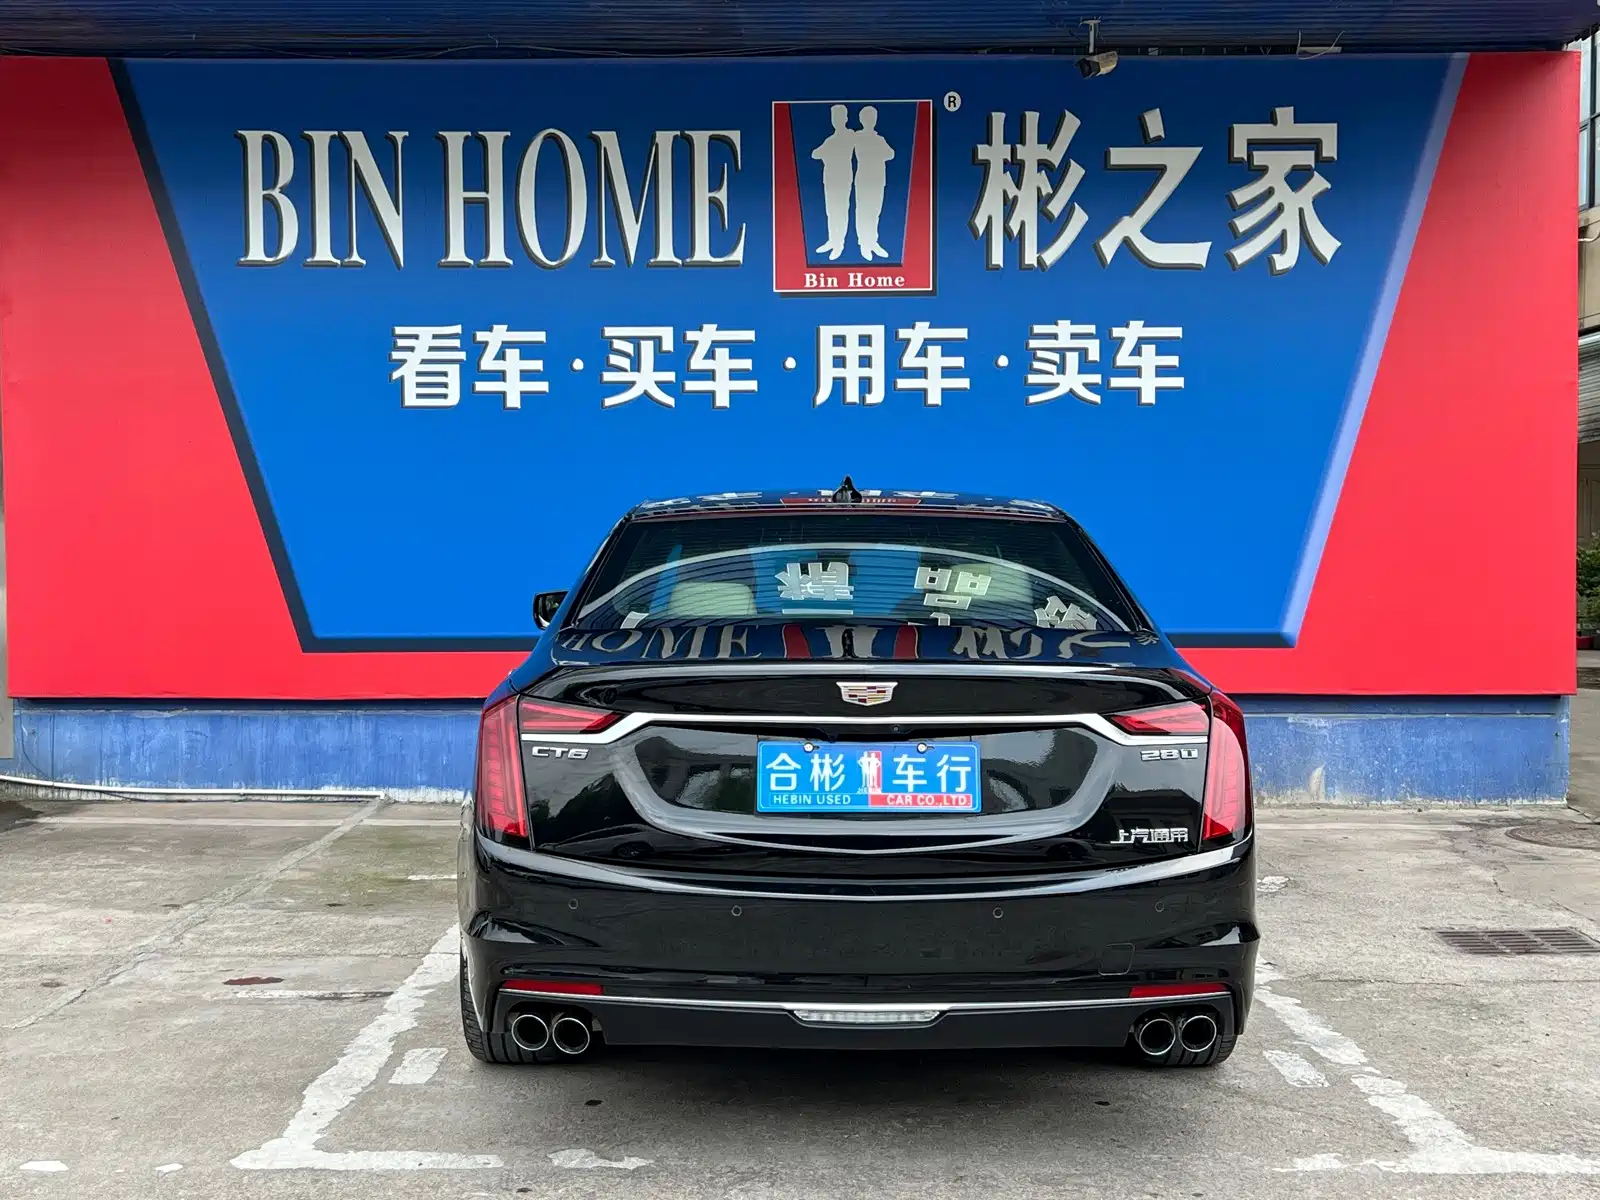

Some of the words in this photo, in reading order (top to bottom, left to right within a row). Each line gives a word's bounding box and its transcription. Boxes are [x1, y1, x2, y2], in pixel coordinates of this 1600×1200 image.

[236, 129, 408, 268] BIN
[436, 128, 747, 268] HOME
[970, 107, 1342, 275] 彬之家
[804, 273, 839, 288] Bin
[848, 272, 905, 288] Home
[532, 746, 590, 760] CT6
[1140, 748, 1199, 762] 28T
[765, 752, 847, 792] 合彬
[892, 753, 973, 794] 车行
[773, 794, 812, 805] HEBIN
[816, 794, 851, 805] USED
[886, 794, 912, 805] CAR
[1110, 826, 1189, 844] 上汽通用
